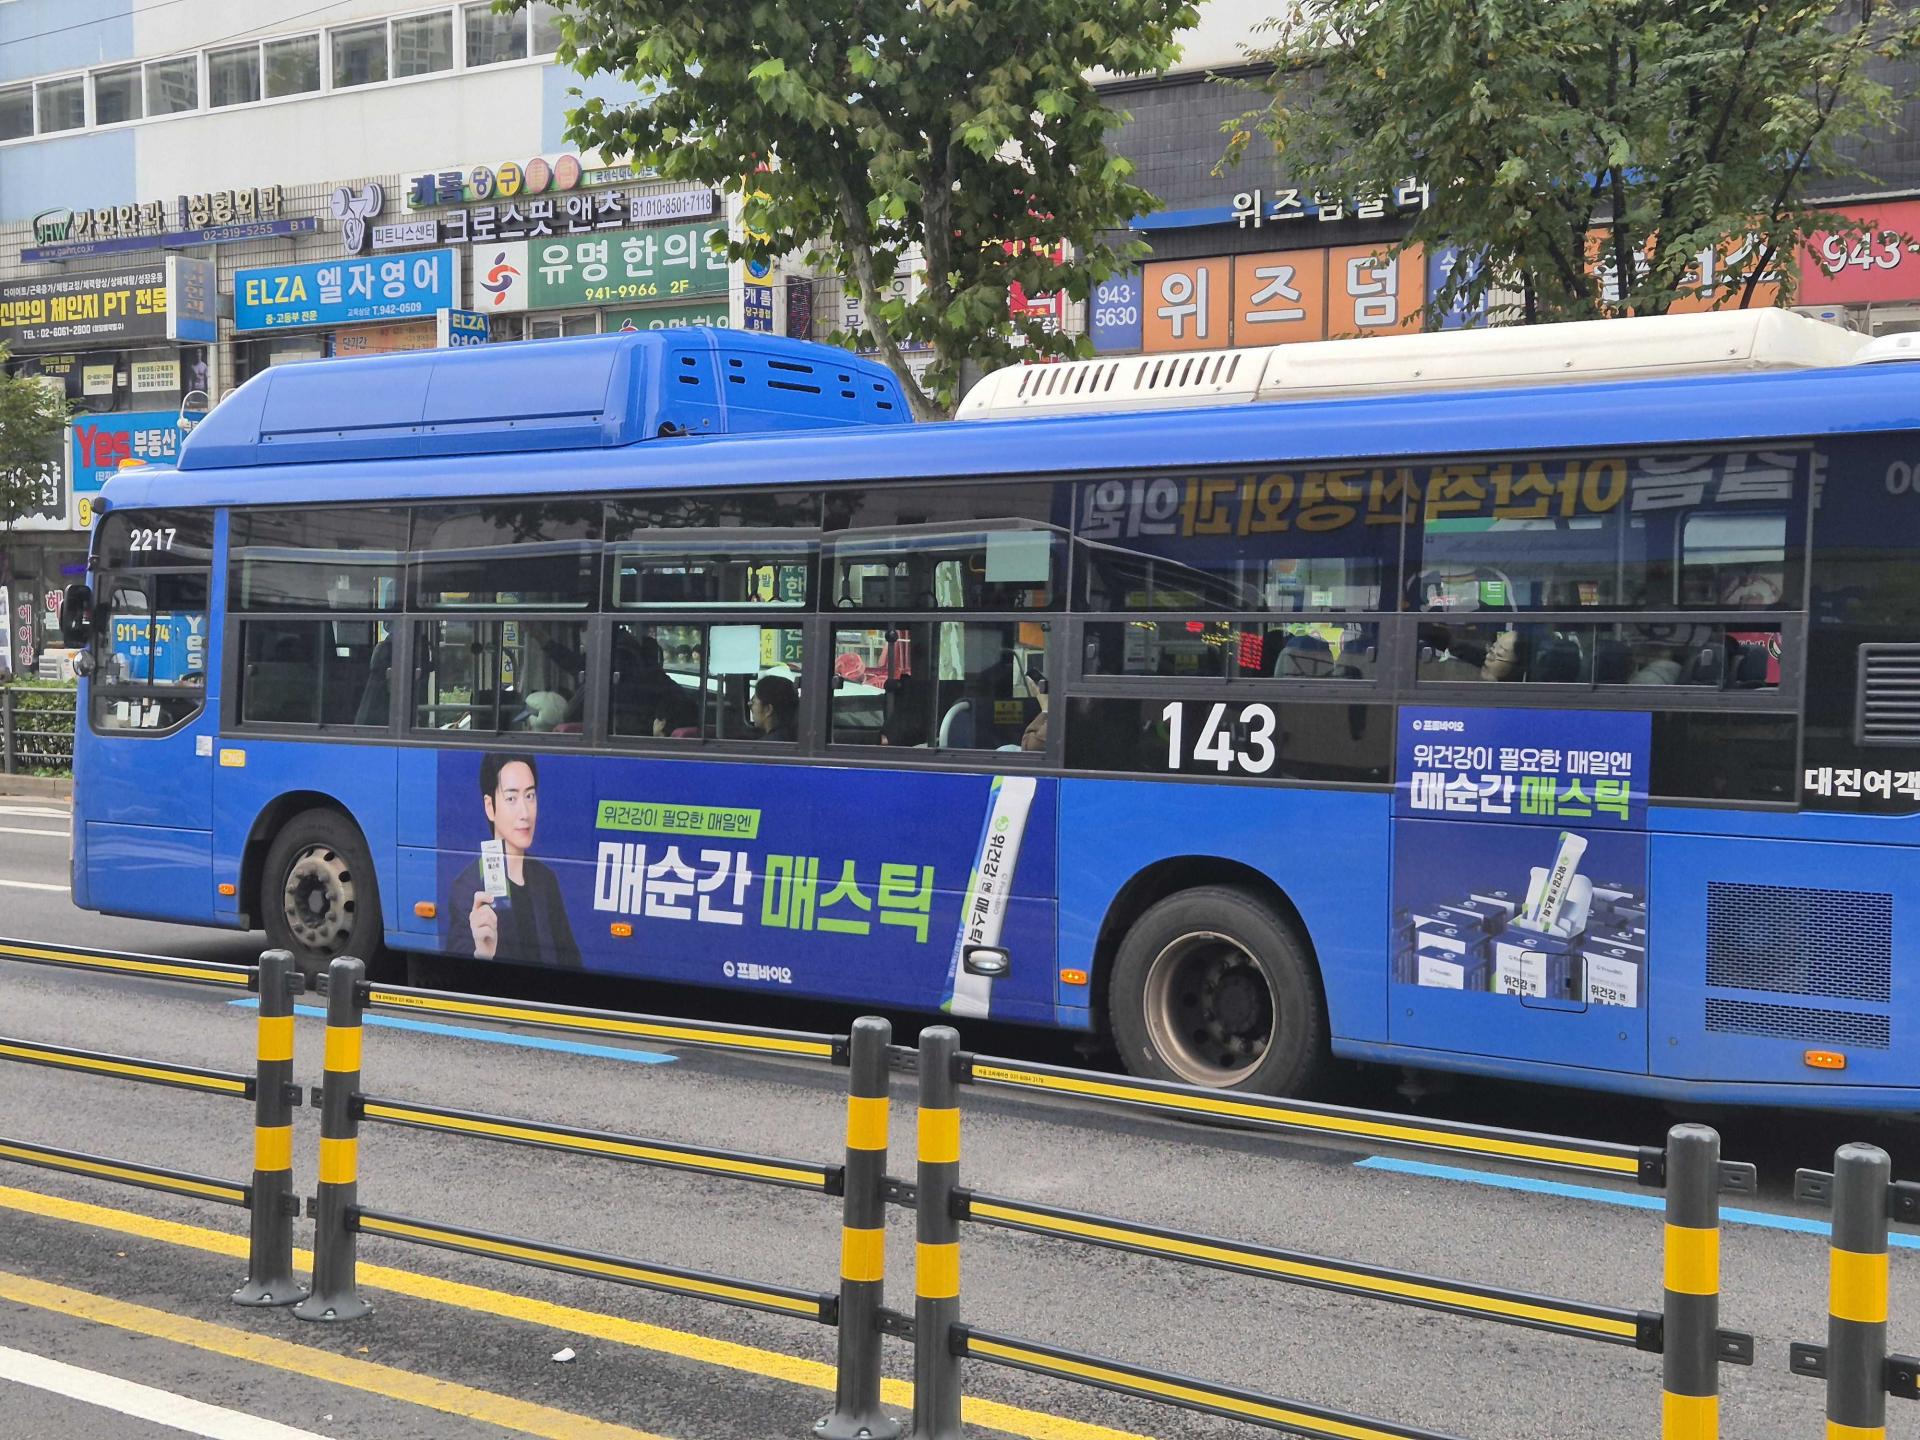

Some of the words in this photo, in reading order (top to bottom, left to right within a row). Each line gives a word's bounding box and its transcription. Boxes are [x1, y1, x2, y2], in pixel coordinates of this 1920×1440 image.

[75, 200, 165, 238] 가인안과
[189, 184, 285, 227] 성형외과
[444, 200, 553, 244] 크로스핏
[566, 191, 623, 233] 앤츠
[203, 224, 273, 241] 02-919-5255
[375, 223, 435, 245] 피트니스센터
[538, 239, 609, 285] 유명
[246, 276, 308, 306] ELZA
[316, 255, 439, 304] 엘자영어
[585, 282, 658, 301] 941-9966
[670, 279, 690, 294] 2F
[745, 288, 772, 307] 캐롬
[50, 293, 99, 322] 체인지
[103, 290, 130, 317] PT
[135, 287, 167, 315] 전문
[1095, 306, 1137, 327] 5630
[453, 314, 486, 331] ELZA
[753, 319, 764, 330] B1
[74, 424, 132, 469] Yes
[134, 429, 177, 457] 부동산
[130, 528, 177, 551] 2217
[1162, 701, 1276, 774] 143
[1413, 744, 1493, 770] 위건강이
[1499, 747, 1562, 773] 필요한
[1566, 750, 1632, 777] 매일엔
[1410, 771, 1516, 814] 매순간
[1519, 775, 1630, 821] 매스틱
[602, 806, 658, 827] 위건강이
[662, 809, 704, 830] 필요한
[707, 811, 752, 833] 매일엔
[983, 834, 1006, 878] 위건강
[593, 841, 753, 926] 매순간
[760, 853, 935, 944] 매스틱
[968, 896, 990, 945] 매스틱
[736, 961, 793, 984] 프롬바이오
